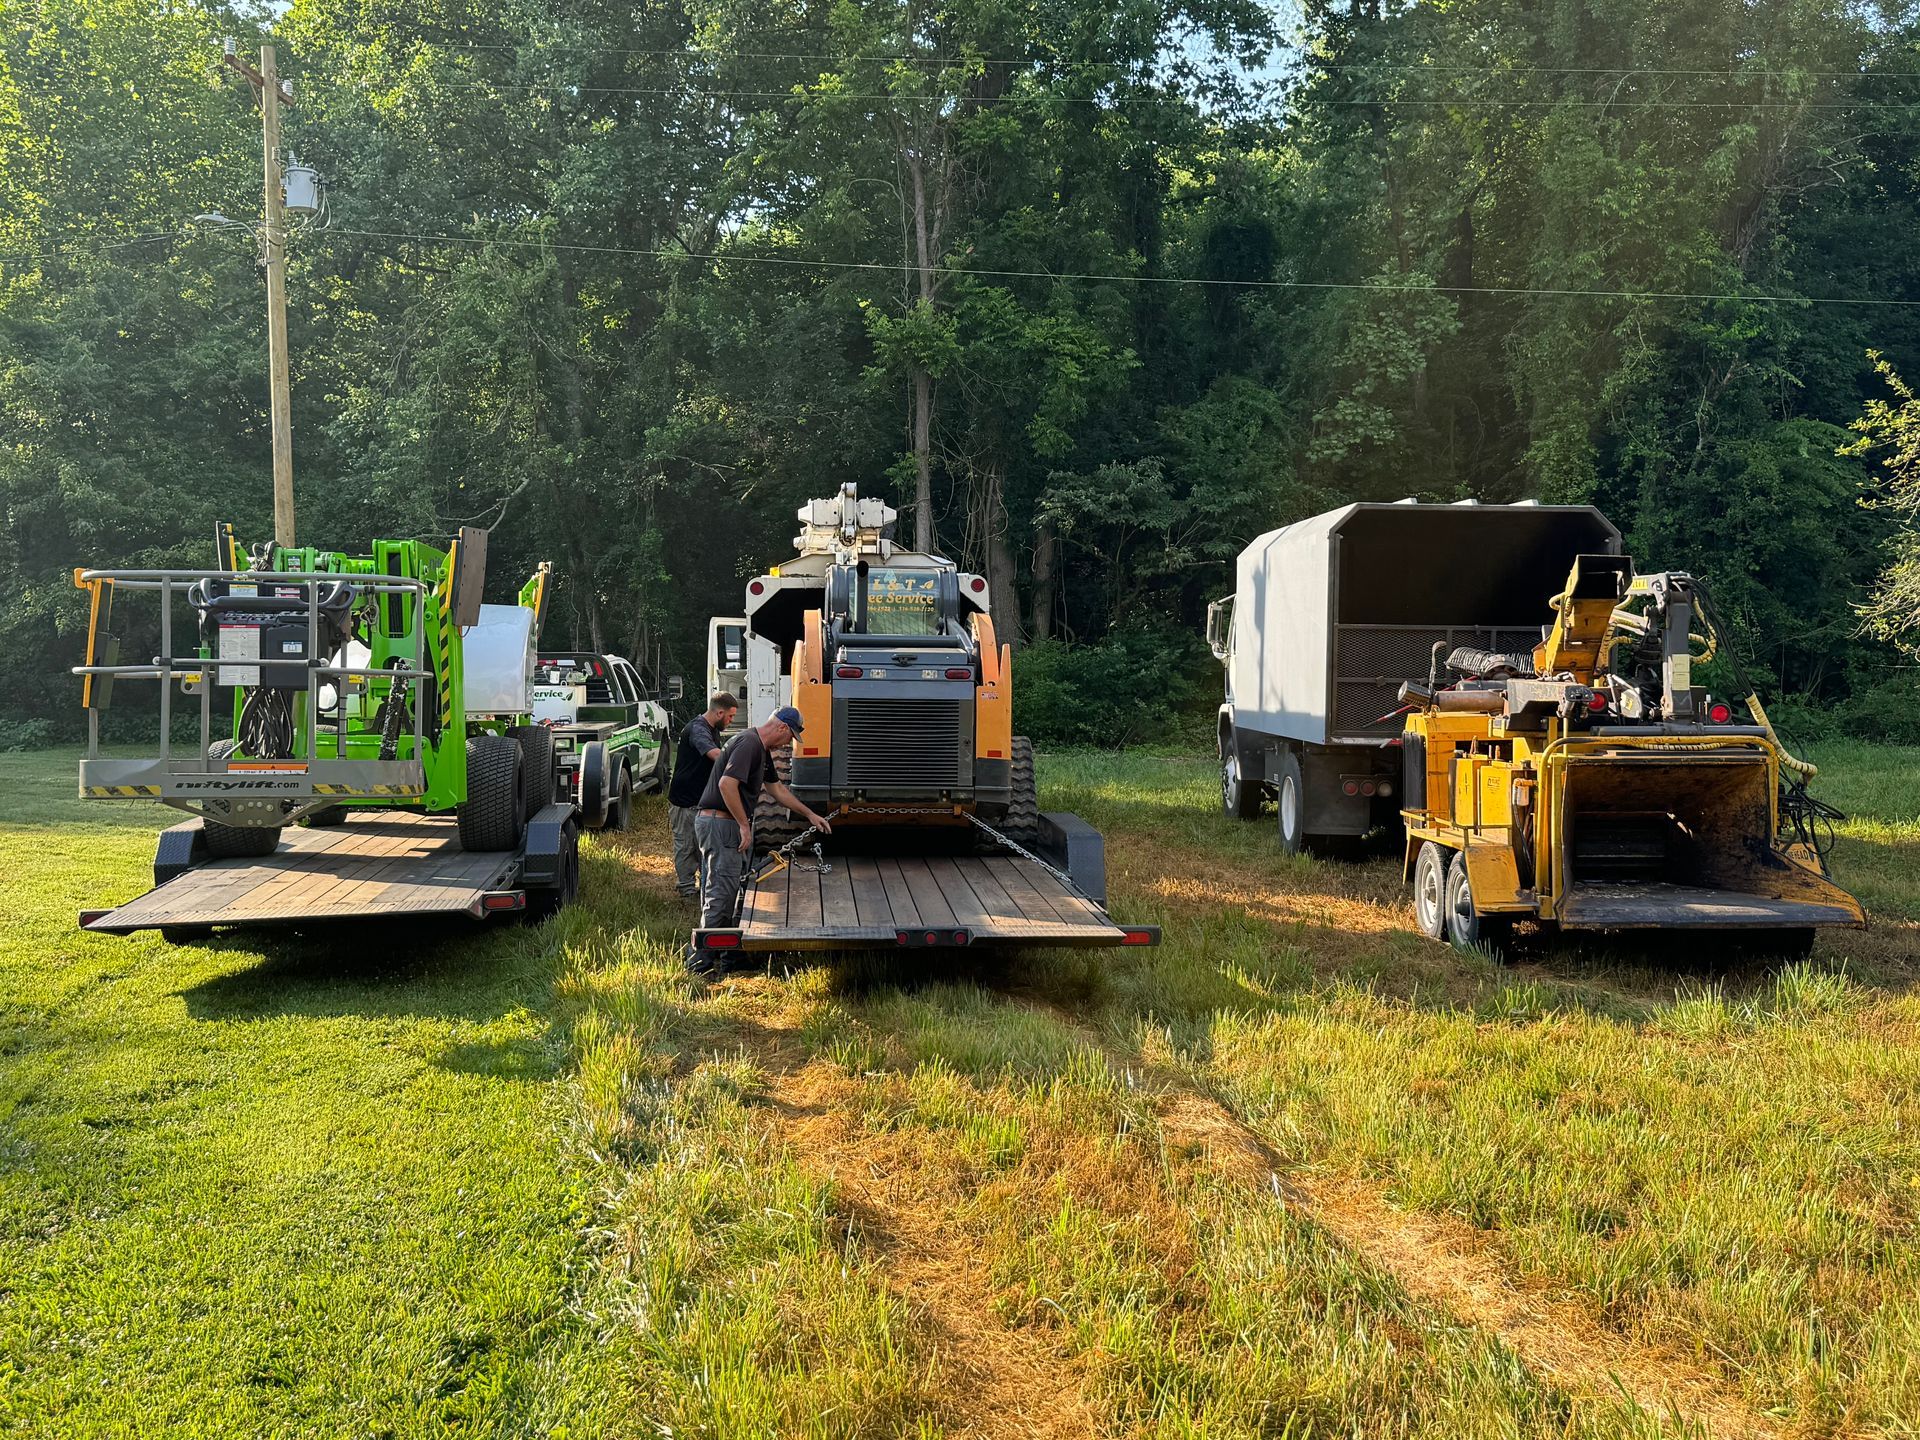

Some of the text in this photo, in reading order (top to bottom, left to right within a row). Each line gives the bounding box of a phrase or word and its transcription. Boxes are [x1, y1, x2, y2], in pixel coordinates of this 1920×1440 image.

[887, 579, 901, 591] &
[905, 579, 916, 591] T
[868, 592, 934, 604] ee Service
[533, 689, 563, 698] ervice
[175, 780, 299, 790] niftylift.com
